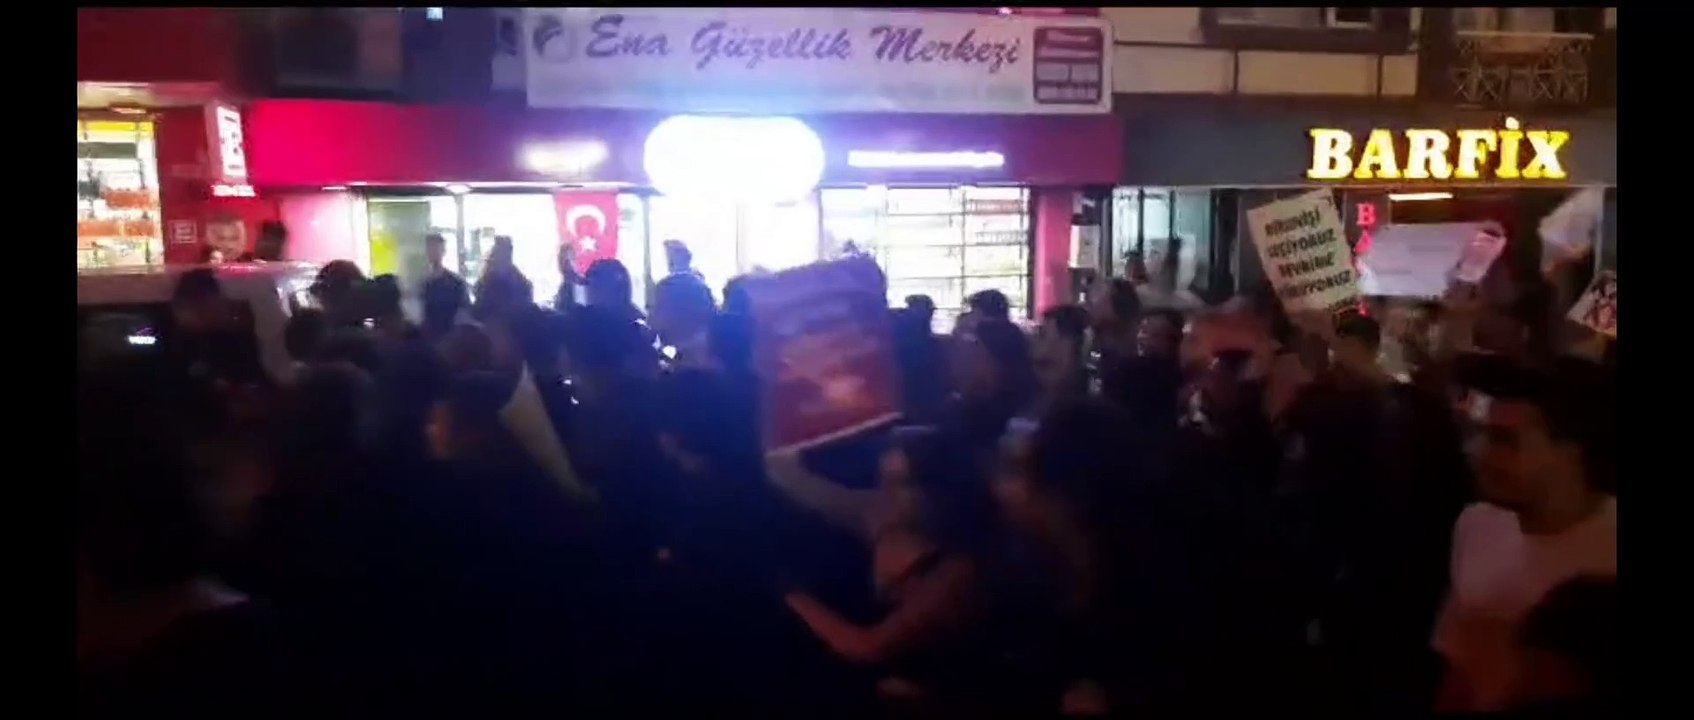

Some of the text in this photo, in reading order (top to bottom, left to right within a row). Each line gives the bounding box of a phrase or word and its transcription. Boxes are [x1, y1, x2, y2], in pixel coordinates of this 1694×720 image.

[584, 15, 672, 60] Ena
[690, 23, 853, 70] Güzellik
[869, 25, 1022, 73] Merkezi
[1306, 117, 1570, 180] BARFİX
